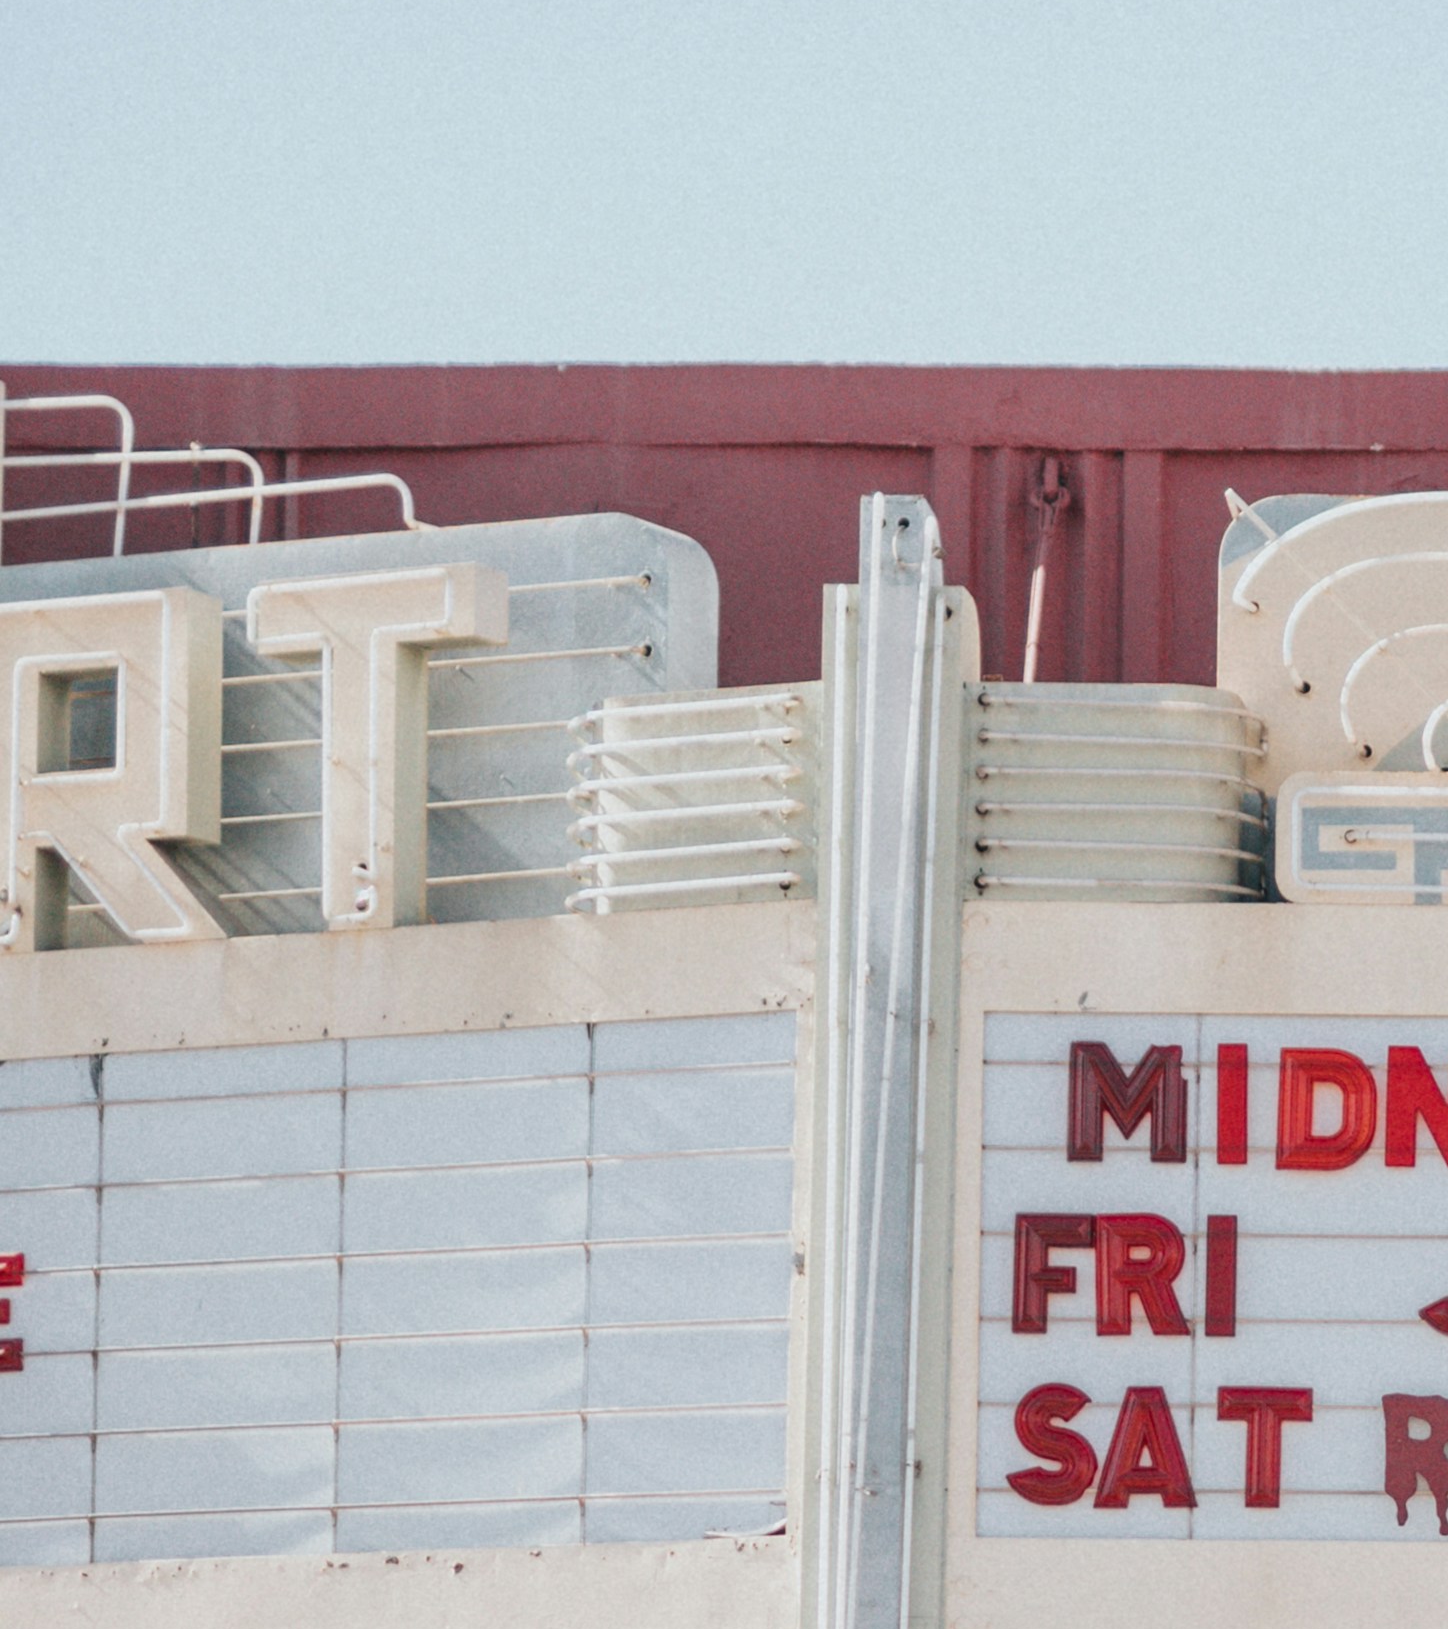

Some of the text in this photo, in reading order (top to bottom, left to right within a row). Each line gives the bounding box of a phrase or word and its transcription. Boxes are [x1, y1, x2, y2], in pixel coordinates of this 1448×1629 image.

[0, 561, 509, 954] RT
[1011, 1213, 1238, 1337] FRI
[1006, 1383, 1314, 1508] SAT
